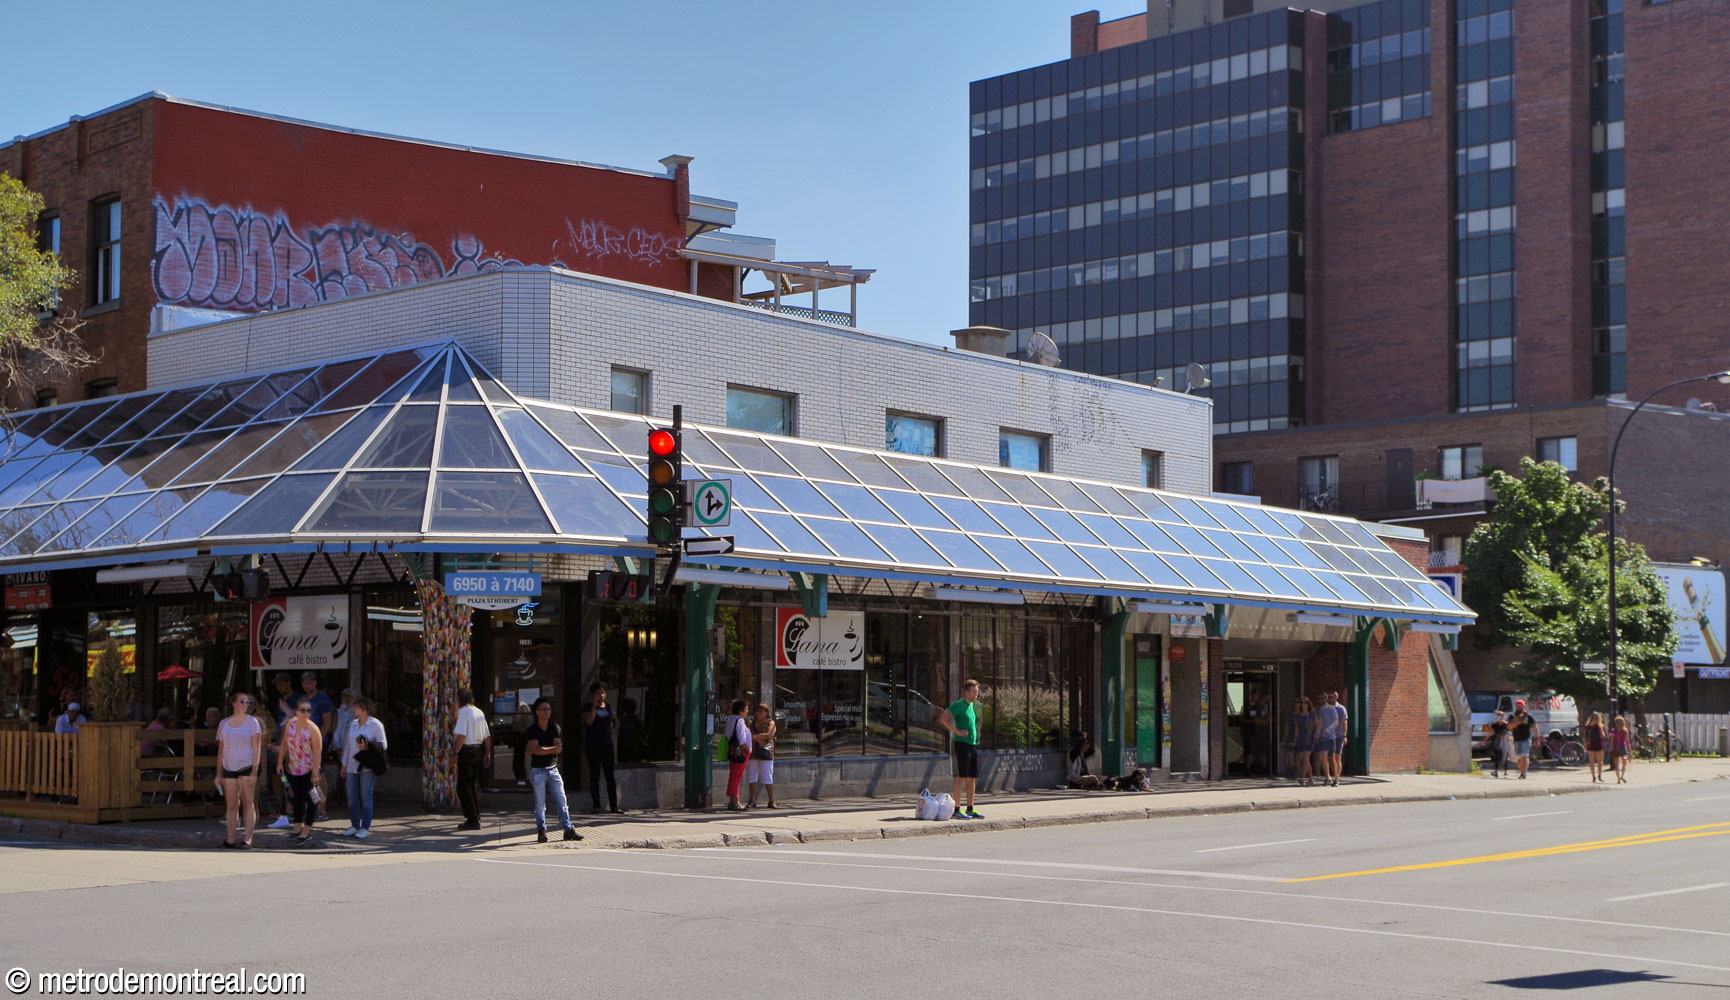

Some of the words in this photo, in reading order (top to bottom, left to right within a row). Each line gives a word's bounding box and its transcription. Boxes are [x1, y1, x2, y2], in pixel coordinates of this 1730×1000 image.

[453, 577, 487, 592] 6950
[491, 577, 500, 592] à
[503, 577, 535, 592] 7140
[288, 654, 305, 665] café
[306, 655, 328, 665] bistro
[828, 656, 847, 666] bistro
[821, 712, 842, 723] Espresso
